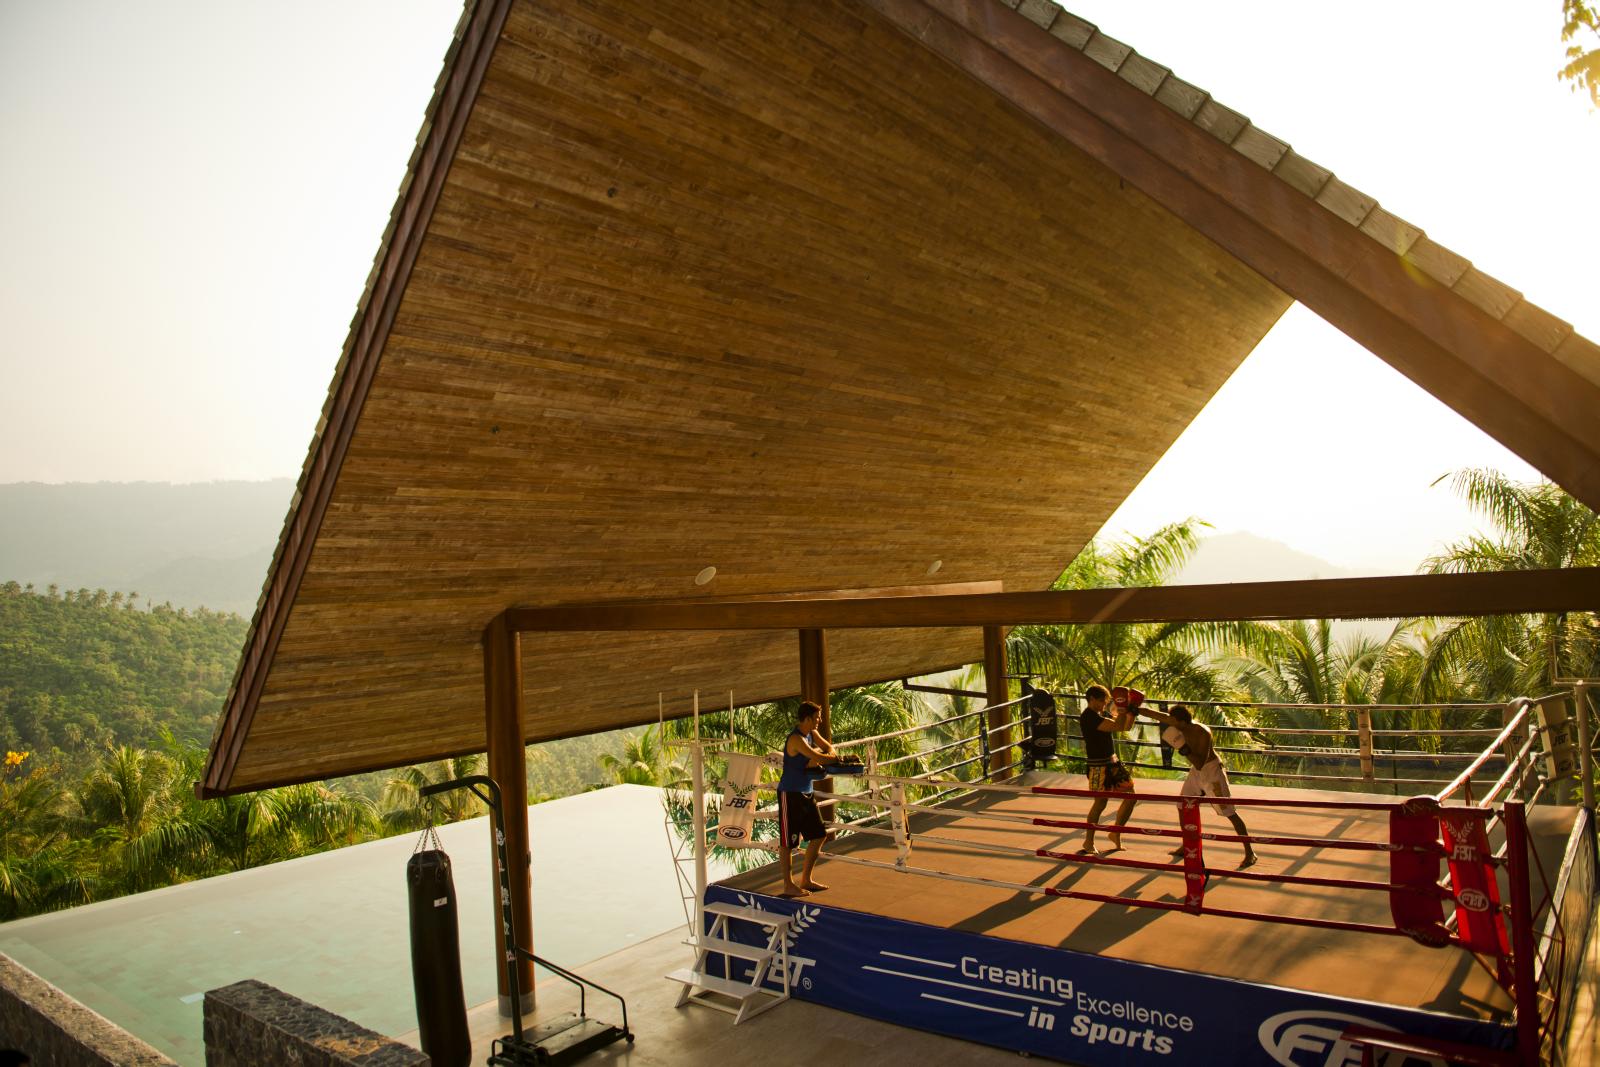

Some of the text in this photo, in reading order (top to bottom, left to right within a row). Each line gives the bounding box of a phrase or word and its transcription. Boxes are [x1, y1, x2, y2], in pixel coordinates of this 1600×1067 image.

[726, 798, 752, 808] FBT
[1450, 845, 1476, 861] FBT
[961, 957, 1073, 999] Creating
[1028, 1006, 1174, 1055] in Sports
[1077, 992, 1194, 1032] Excellence
